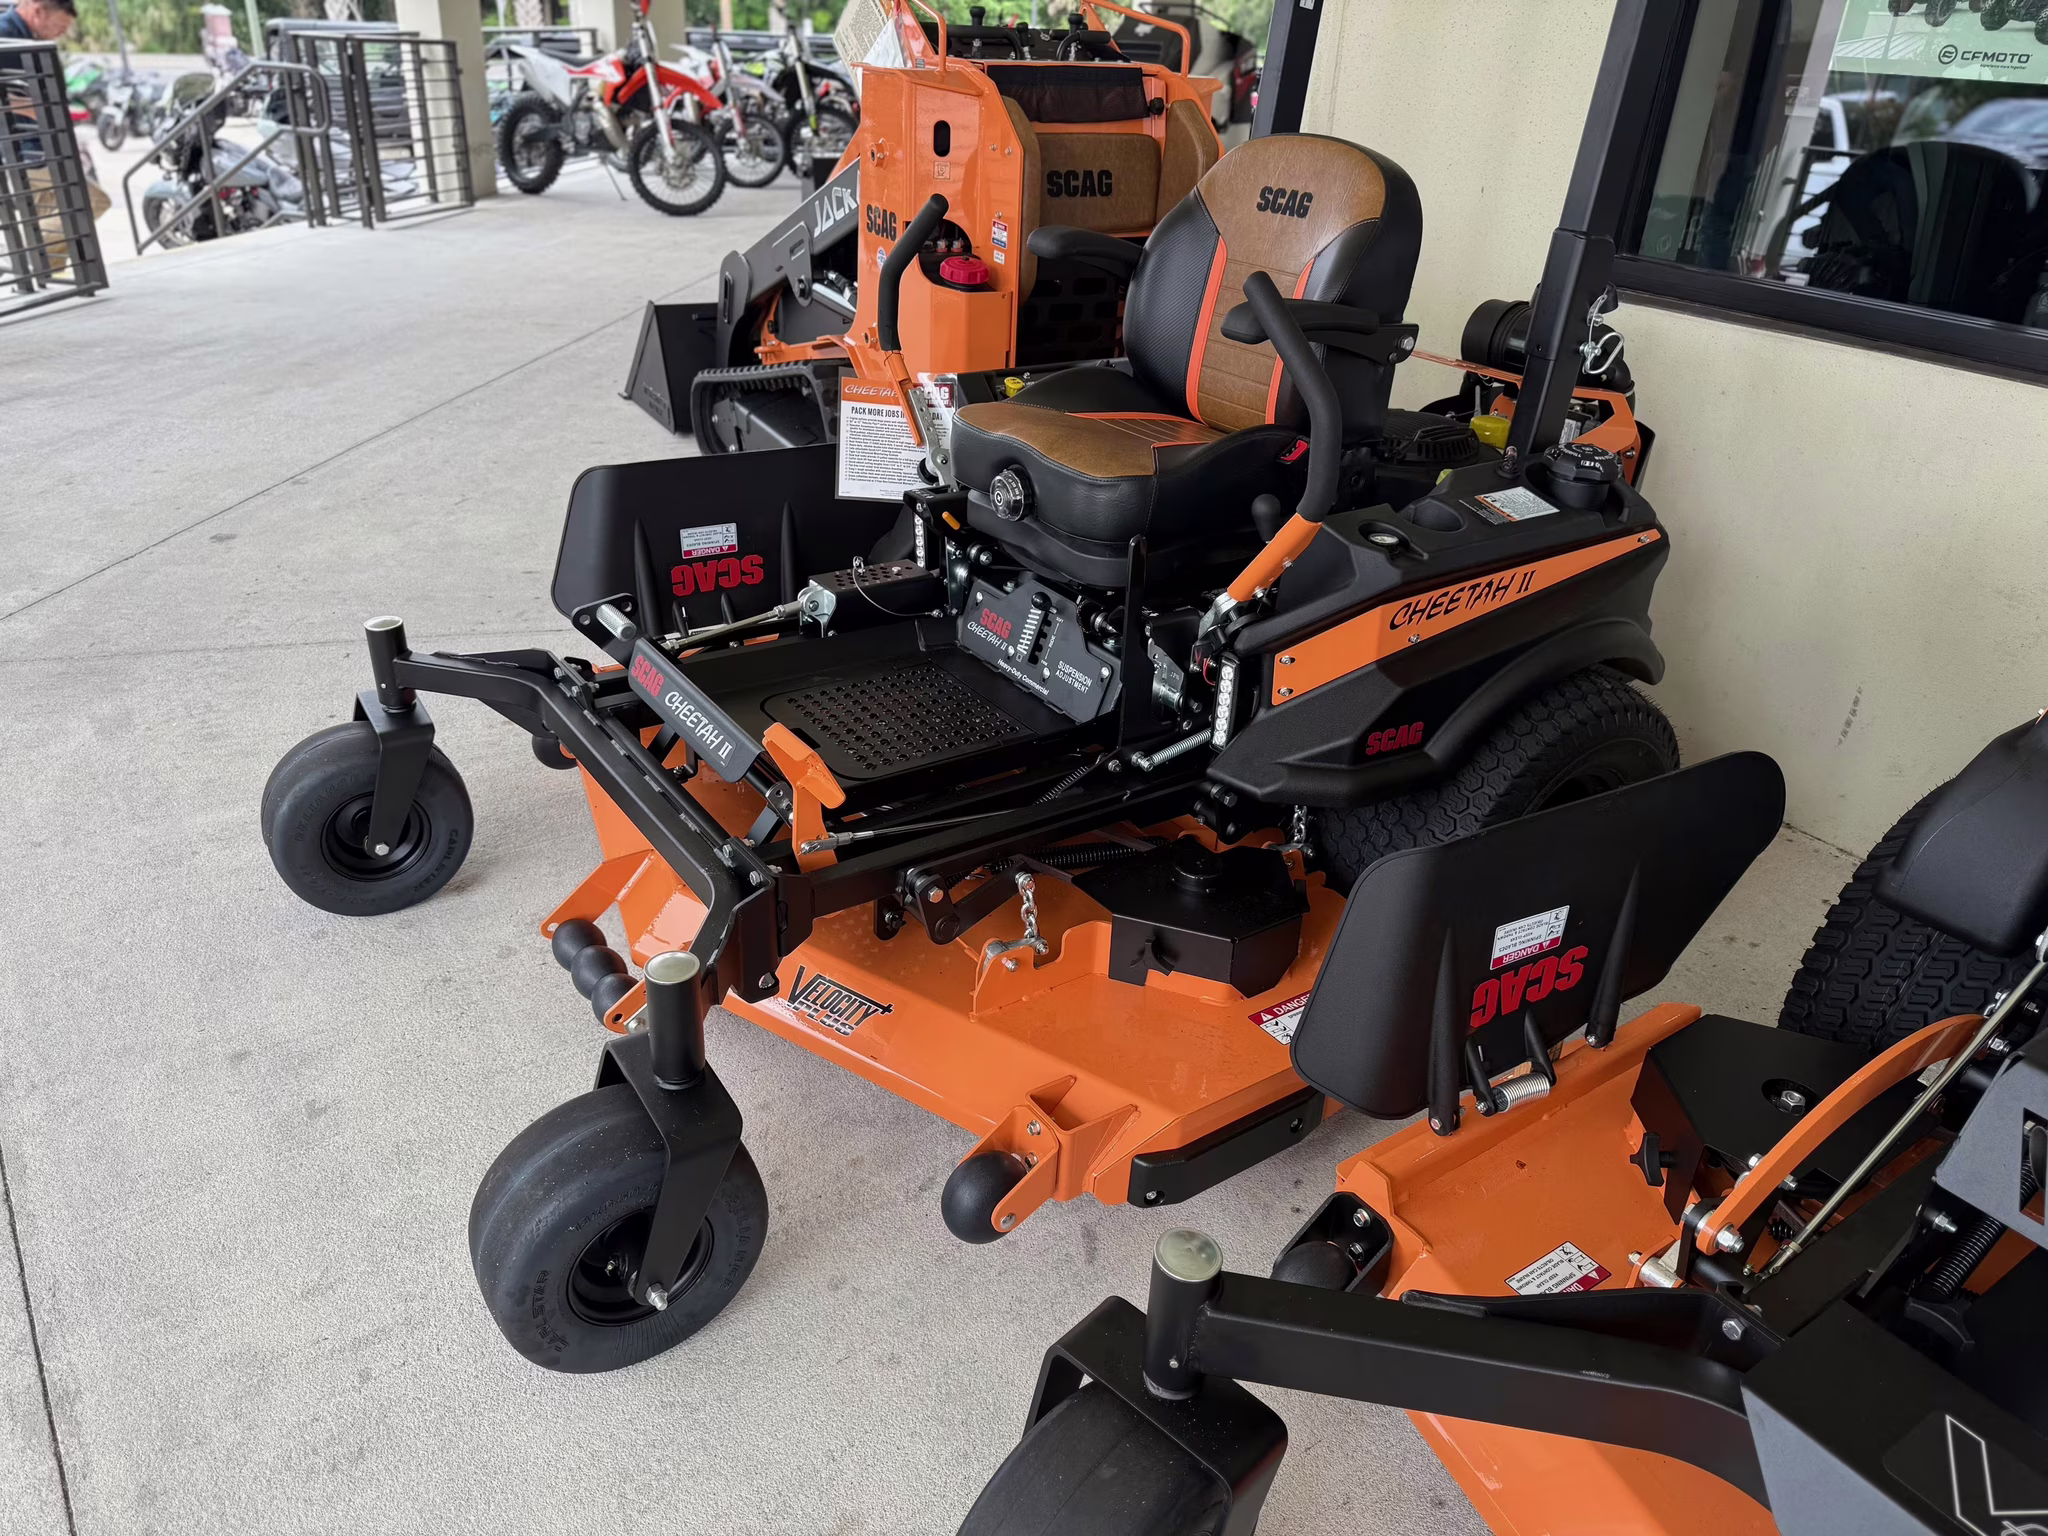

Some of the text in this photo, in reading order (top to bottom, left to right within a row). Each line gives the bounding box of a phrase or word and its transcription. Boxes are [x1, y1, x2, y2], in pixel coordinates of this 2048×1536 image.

[1961, 51, 2032, 63] CFMOTO
[1046, 170, 1113, 198] SCAG
[1256, 185, 1314, 219] SCAG
[866, 204, 897, 241] SCAG
[851, 406, 867, 416] PACK
[867, 408, 884, 417] MORE
[885, 409, 900, 418] JOBS
[692, 547, 720, 556] DANGER
[671, 554, 764, 596] SCAG
[1389, 570, 1537, 631] CHEETAH II
[967, 621, 1003, 647] CHEETAH
[980, 608, 1012, 639] SCAG
[997, 659, 1050, 696] Heavy-Duty Commercial
[1055, 670, 1089, 694] ADJUSTMENT
[1058, 660, 1093, 688] SUSPENSION
[631, 655, 733, 759] SCAG CHEETAH II
[1365, 721, 1424, 755] SCAG
[1503, 946, 1540, 963] DANGER
[1470, 945, 1589, 1028] SCAG
[787, 1001, 855, 1036] PLUS
[1273, 993, 1310, 1015] DANGE
